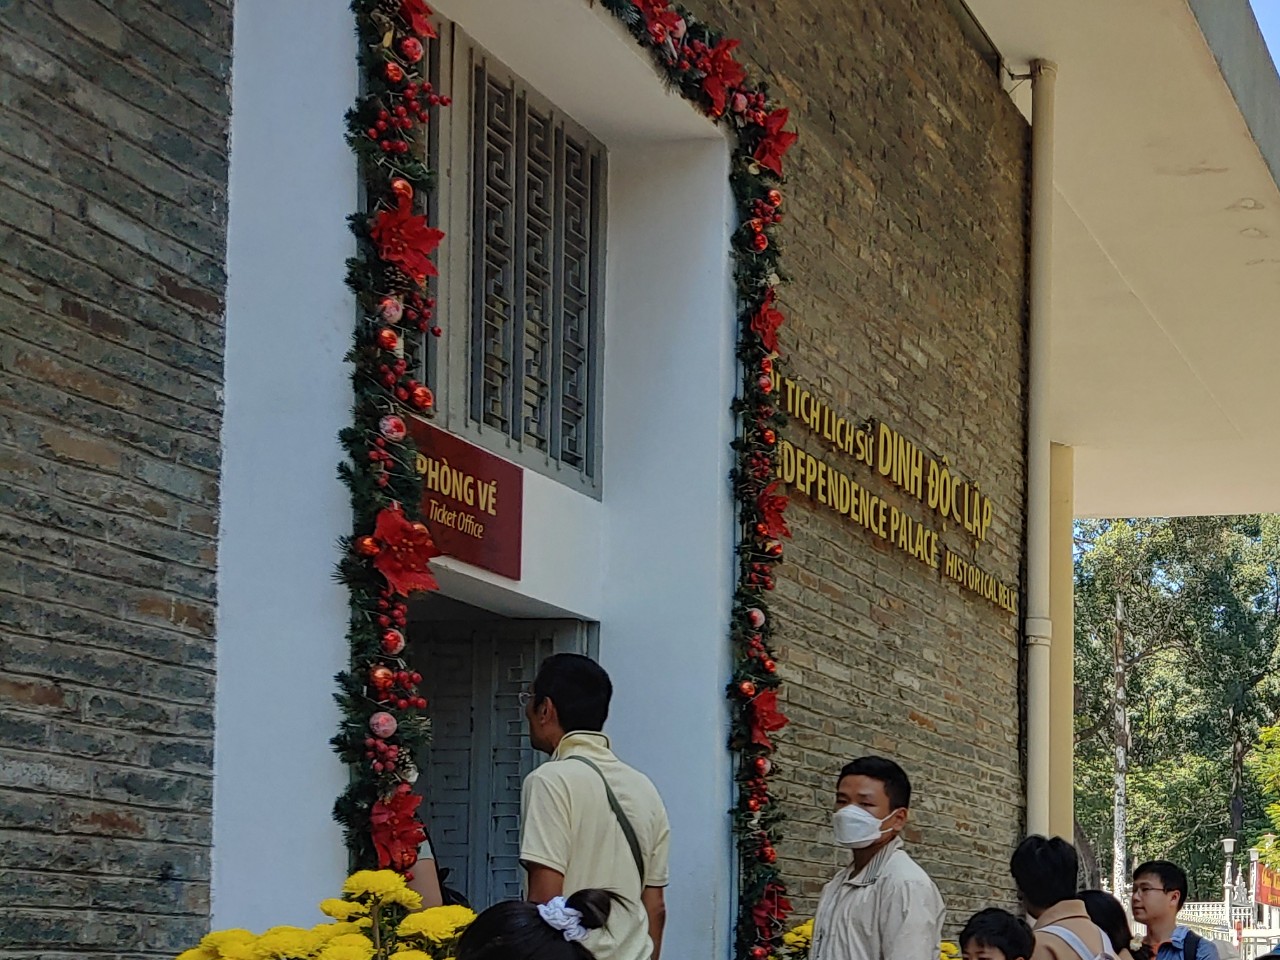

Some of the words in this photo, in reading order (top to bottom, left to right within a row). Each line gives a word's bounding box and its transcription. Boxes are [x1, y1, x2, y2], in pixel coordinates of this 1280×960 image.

[416, 453, 475, 506] PHÒNG
[477, 480, 498, 516] VÉ
[429, 499, 456, 529] Ticket
[457, 511, 484, 539] Office
[878, 422, 923, 500] DINH
[927, 454, 962, 532] ĐỘC
[963, 480, 993, 550] LẬP
[890, 505, 939, 569] PALACE
[945, 550, 998, 603] HISTORICAL
